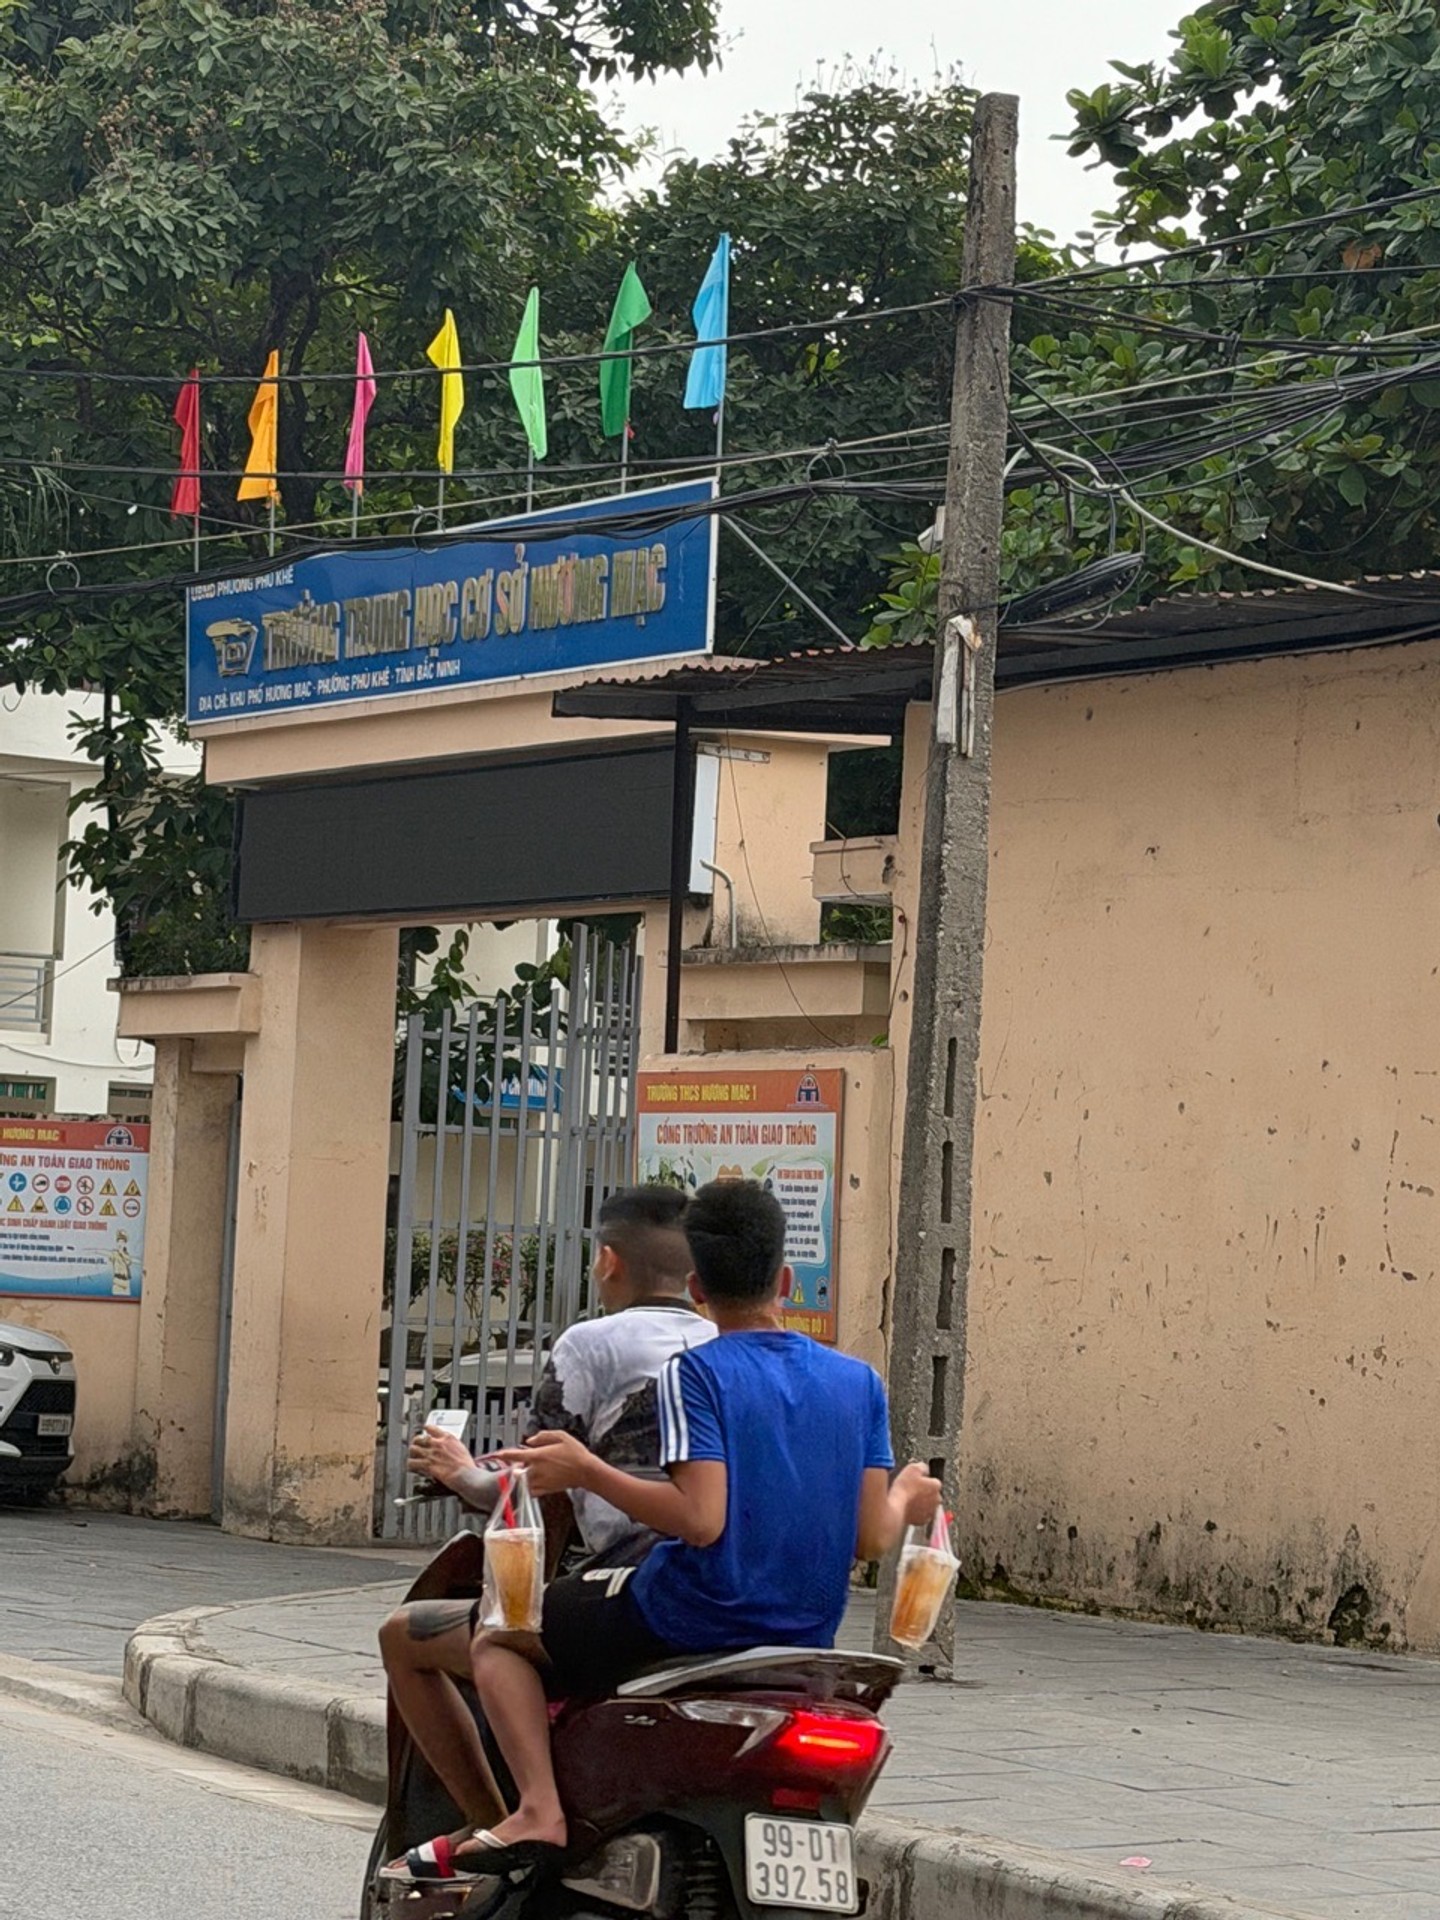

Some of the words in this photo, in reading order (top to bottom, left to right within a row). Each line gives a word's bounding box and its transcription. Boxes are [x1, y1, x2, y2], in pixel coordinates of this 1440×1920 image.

[262, 588, 339, 670] TRƯỜNG
[344, 589, 411, 658] TRUNG
[414, 580, 459, 657] HỌC
[461, 568, 494, 641] CƠ
[495, 543, 529, 636] SỞ
[529, 552, 609, 630] HƯƠNG
[610, 543, 667, 626] MẠC
[199, 695, 213, 715] ĐỊA
[229, 691, 246, 708] KHU
[247, 682, 265, 705] PHỐ
[294, 681, 312, 701] MẠC
[371, 665, 390, 687] KHÊ
[436, 658, 460, 678] NINH
[679, 1084, 700, 1101] THCS
[682, 1119, 718, 1145] TRƯỜNG
[719, 1124, 734, 1145] AN
[735, 1120, 759, 1145] TOÀN
[761, 1124, 783, 1145] GIAO
[784, 1120, 817, 1146] THÔNG
[20, 1155, 36, 1168] AN
[38, 1153, 66, 1169] TOÀN
[68, 1156, 93, 1170] GIAO
[95, 1156, 130, 1171] THÔNG
[763, 1822, 838, 1863] 99-D1
[755, 1862, 848, 1904] 392.58
